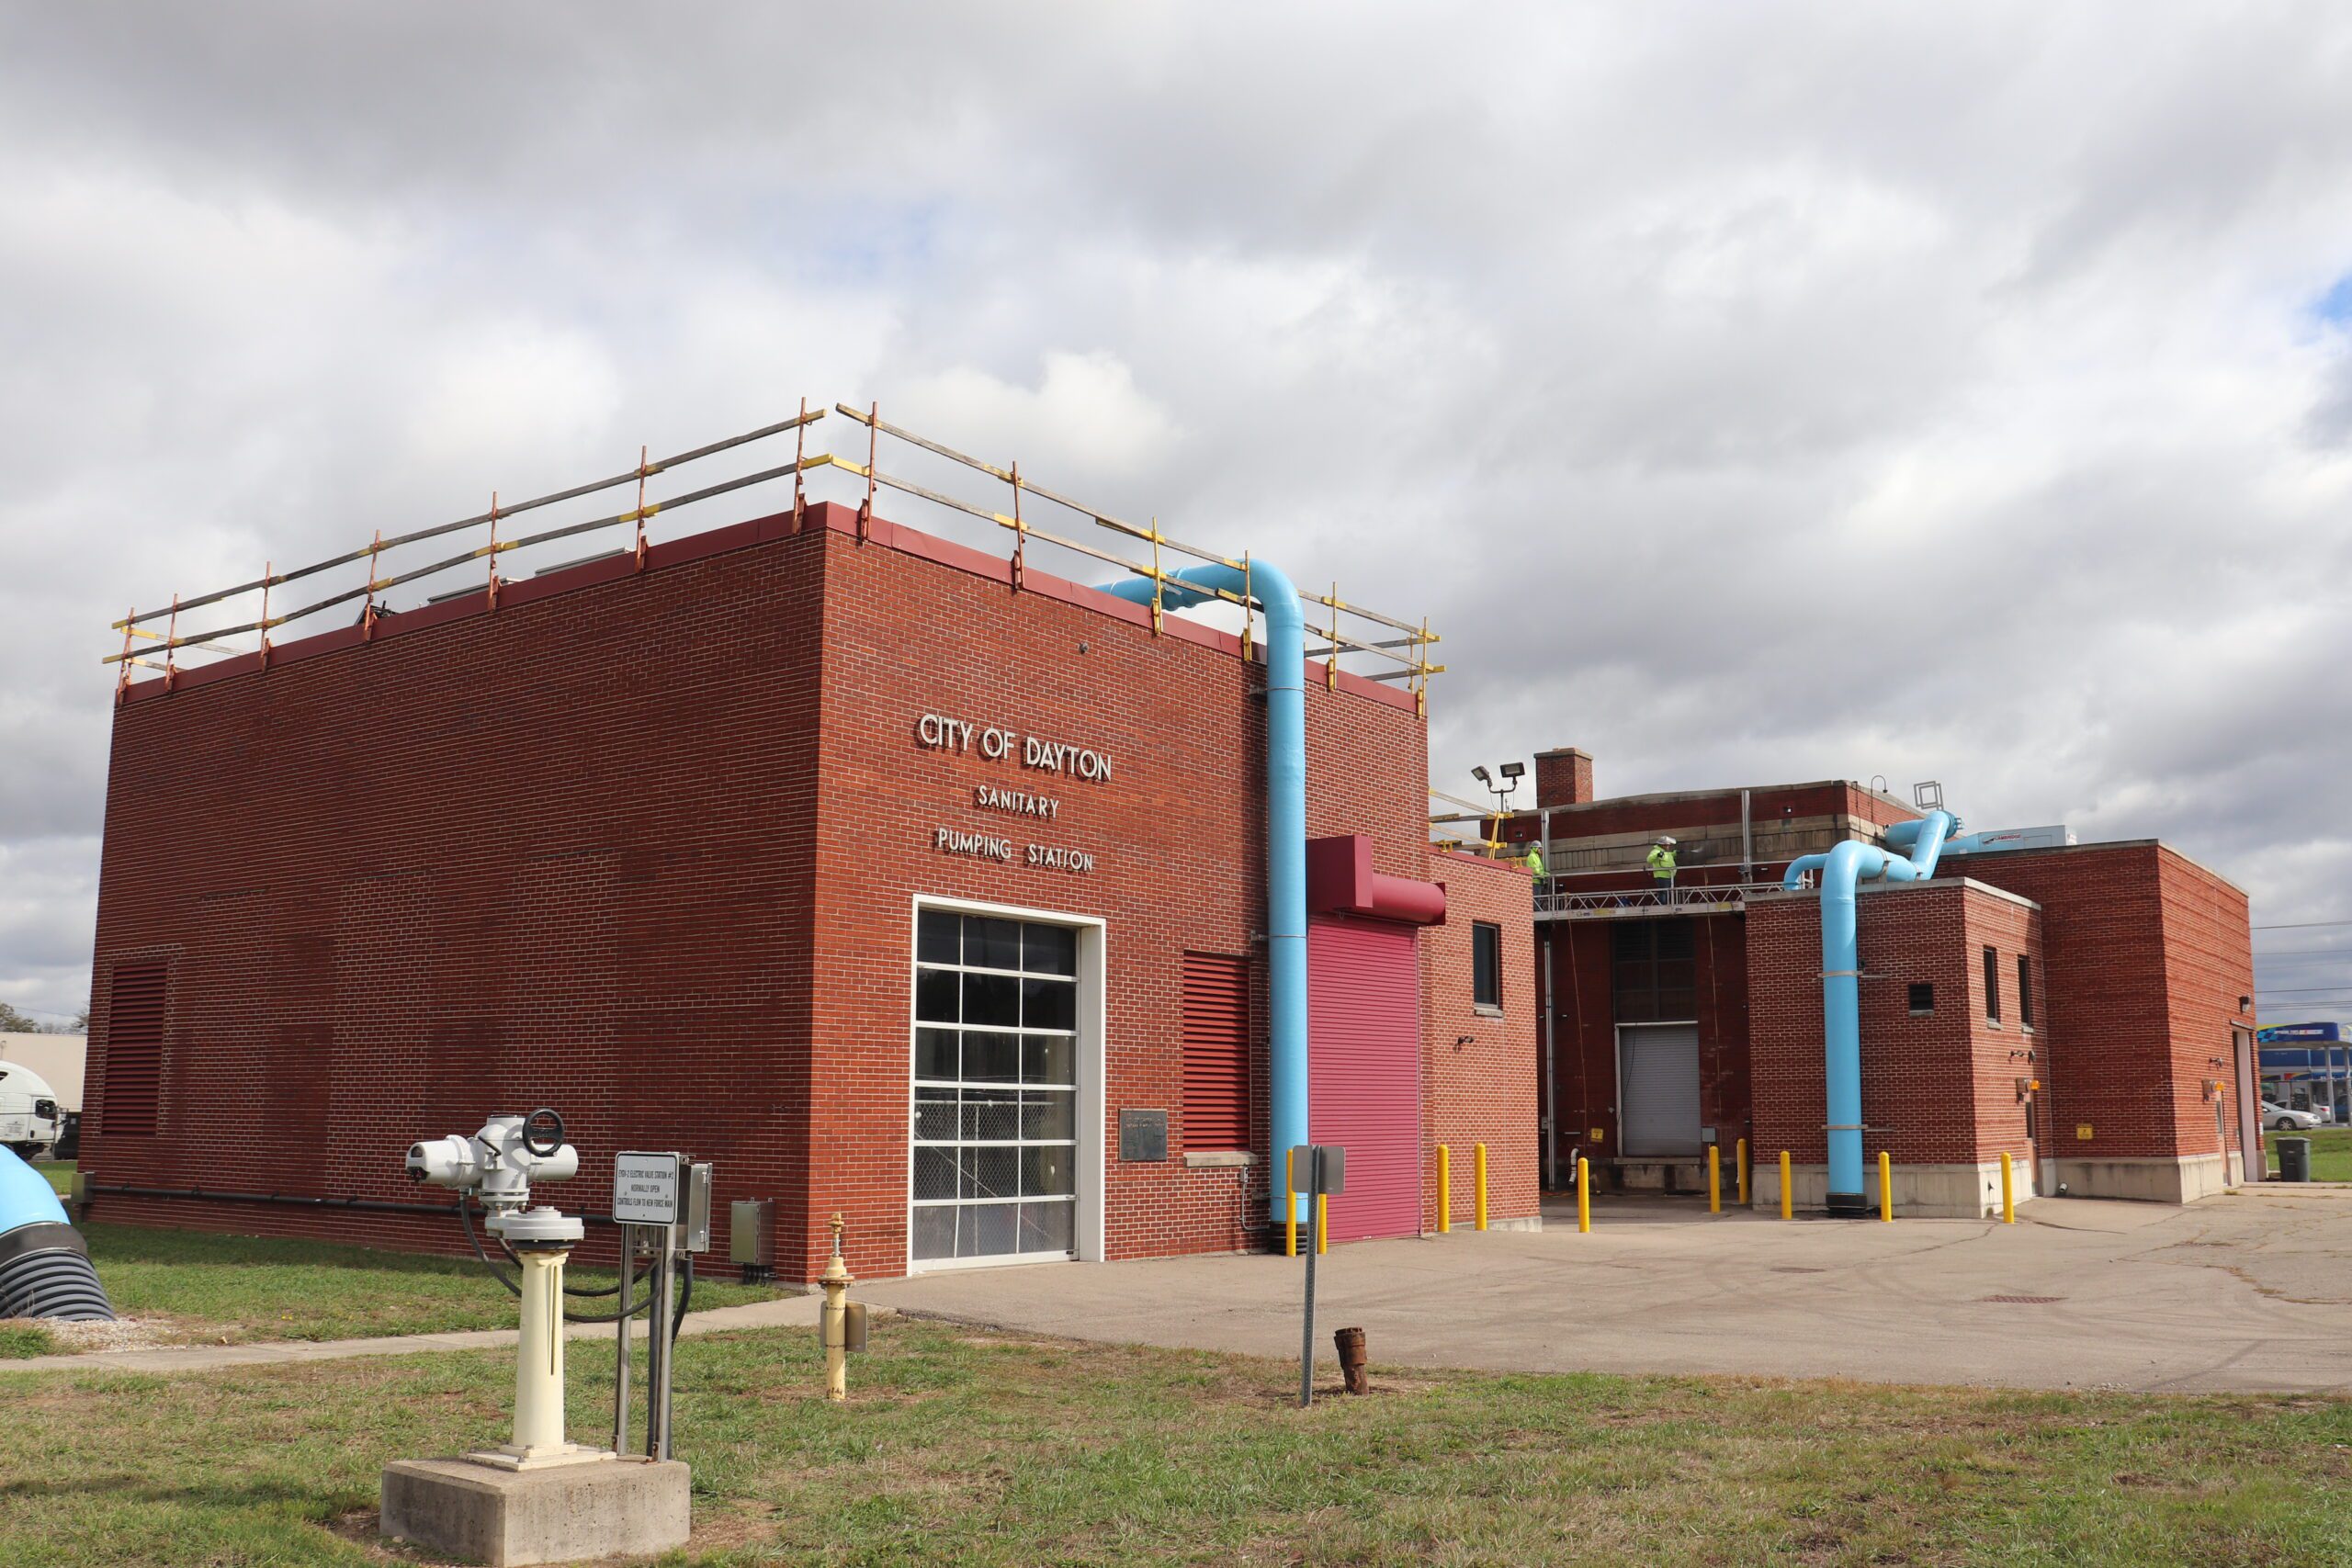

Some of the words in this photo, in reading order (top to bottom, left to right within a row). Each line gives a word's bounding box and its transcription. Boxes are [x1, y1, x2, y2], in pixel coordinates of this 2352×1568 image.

[920, 713, 973, 751] CITY
[982, 728, 1016, 759] OF
[1026, 736, 1112, 781] DAYTON
[978, 784, 1059, 818] SANITARY
[938, 828, 1012, 859] PUMPING
[1028, 843, 1092, 872] STATION
[630, 1169, 644, 1179] ELECTRIC
[645, 1170, 654, 1179] VALVE
[654, 1170, 667, 1179] STATION
[631, 1184, 650, 1192] NORMALLY
[650, 1184, 660, 1192] OPEN
[617, 1197, 632, 1206] CONTROLS
[633, 1198, 641, 1206] FLOW
[641, 1198, 646, 1206] TO
[654, 1199, 664, 1207] FORCE
[664, 1200, 673, 1208] MAIN
